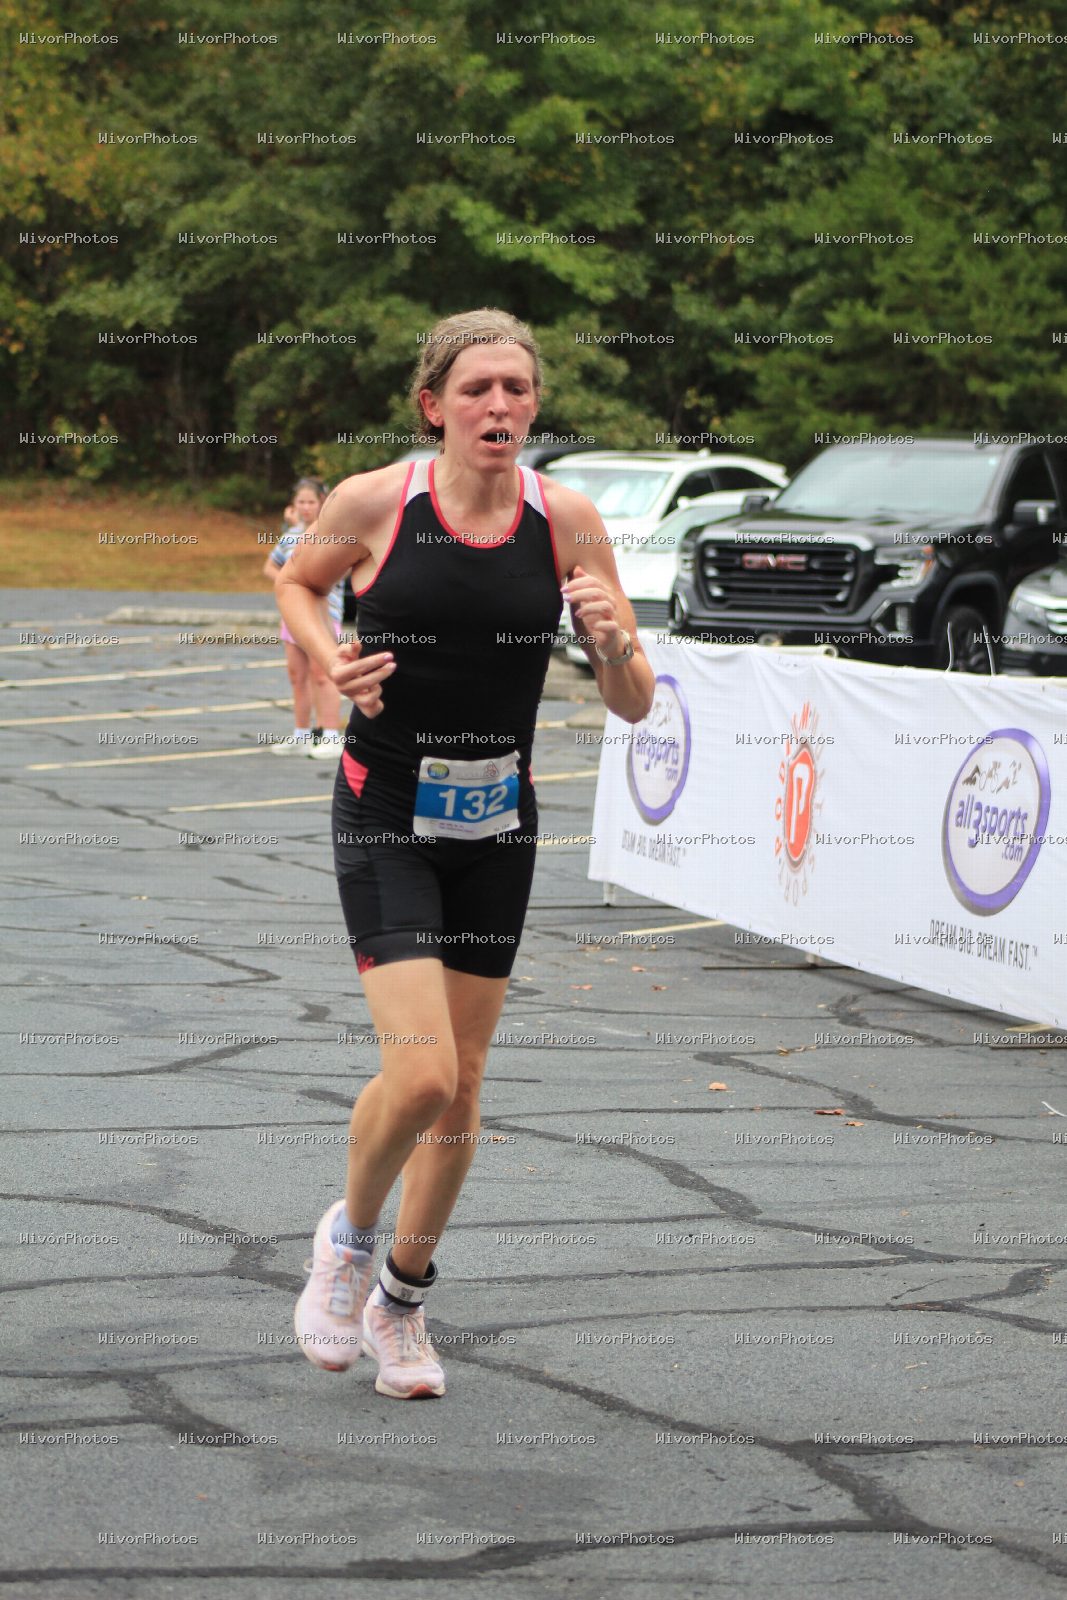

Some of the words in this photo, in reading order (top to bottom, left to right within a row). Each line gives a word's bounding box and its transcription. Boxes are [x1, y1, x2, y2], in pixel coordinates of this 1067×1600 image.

[742, 553, 808, 570] GMC
[438, 785, 508, 820] 132
[955, 794, 1028, 848] all3sports
[1001, 843, 1024, 861] .com
[929, 919, 957, 951] DREAM
[977, 931, 1006, 965] DREAM
